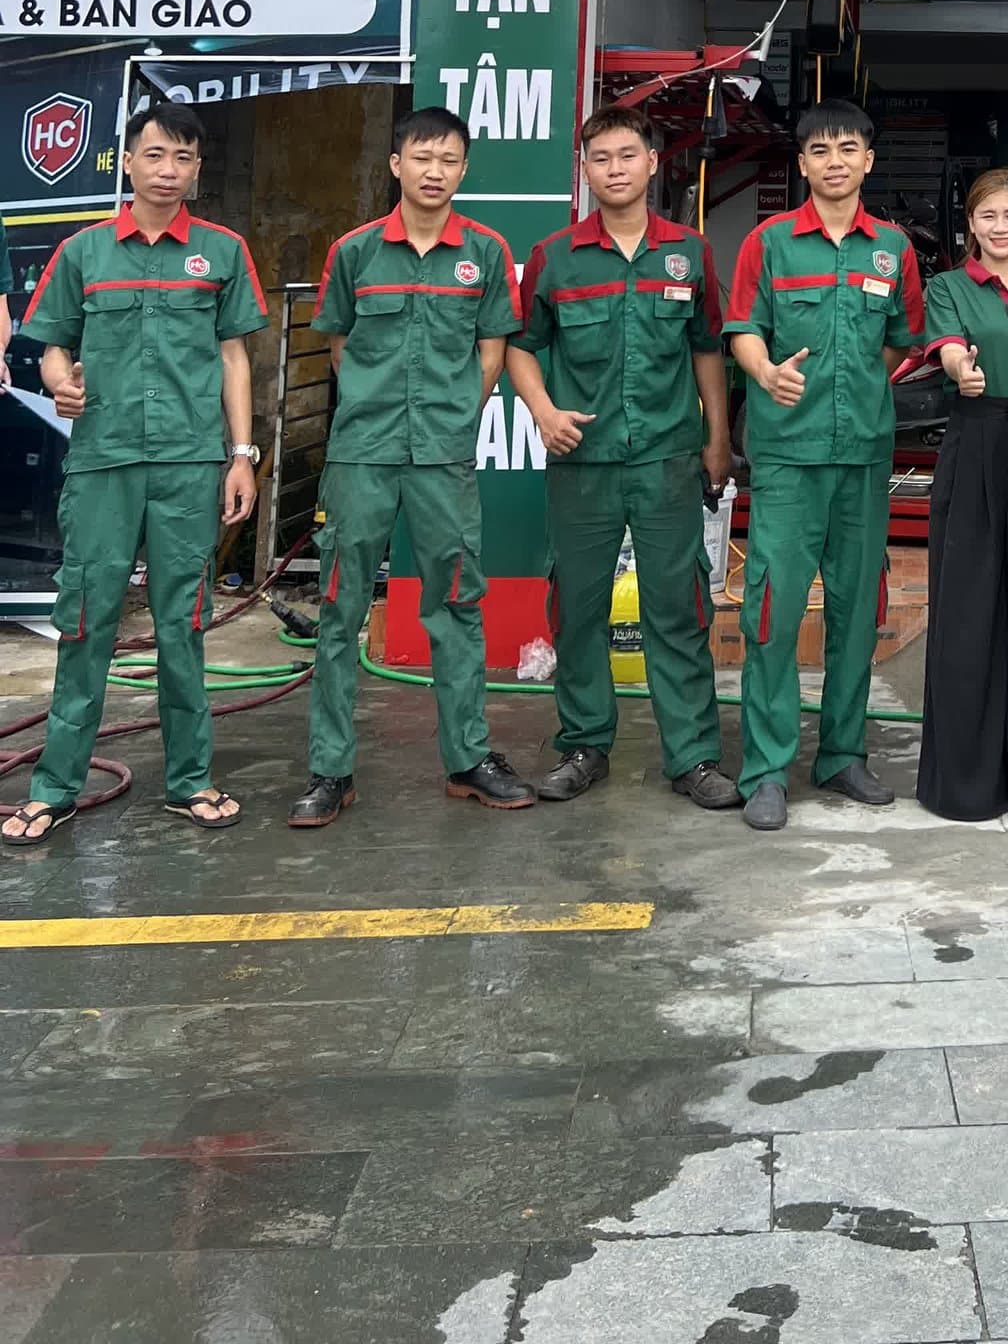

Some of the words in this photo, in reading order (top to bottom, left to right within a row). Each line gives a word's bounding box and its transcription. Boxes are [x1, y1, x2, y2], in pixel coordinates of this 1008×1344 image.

[439, 52, 553, 140] TÂM
[34, 120, 76, 150] HC
[97, 147, 114, 177] HỆ
